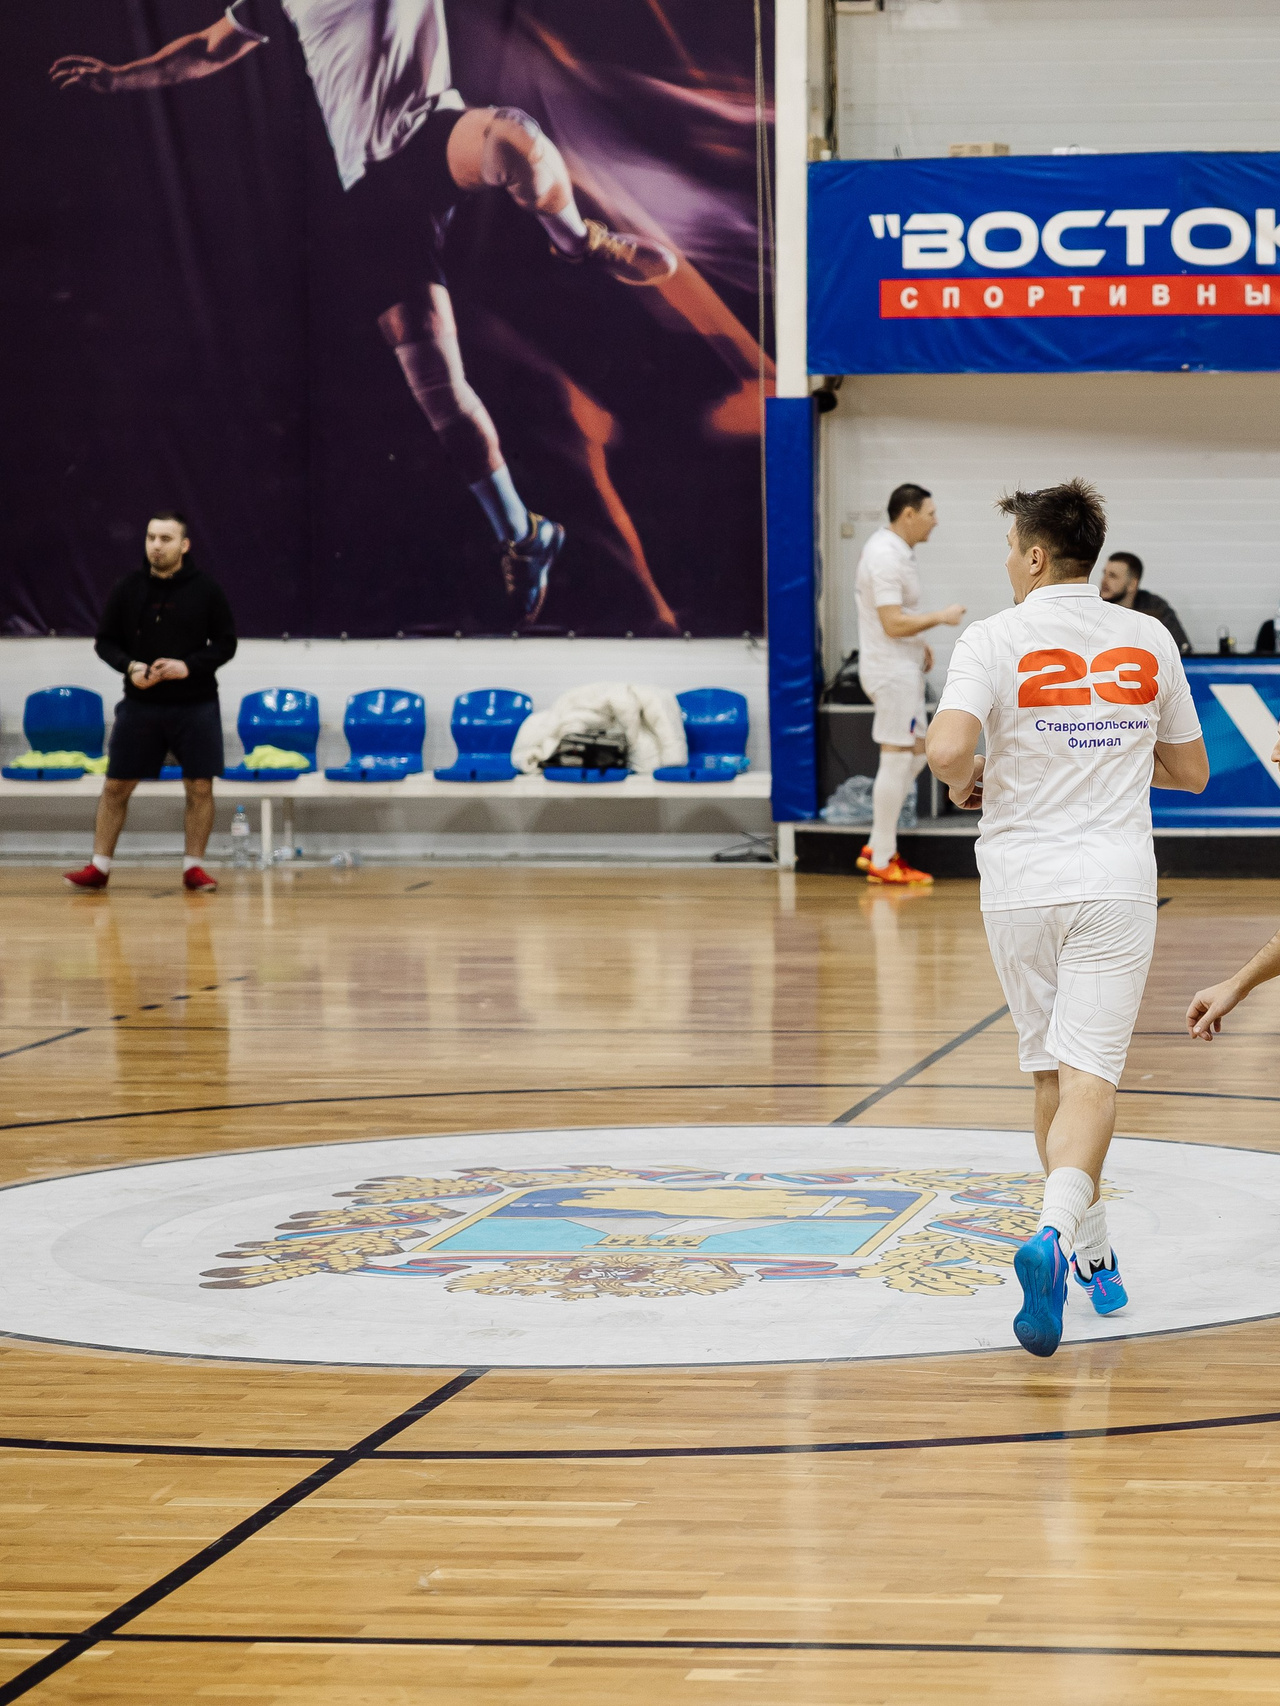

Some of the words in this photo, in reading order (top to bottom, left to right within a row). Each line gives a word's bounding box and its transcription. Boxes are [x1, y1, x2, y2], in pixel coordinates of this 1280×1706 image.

[1017, 646, 1160, 708] 23
[1035, 717, 1150, 735] Ставропольский
[1067, 735, 1122, 749] Филиал
